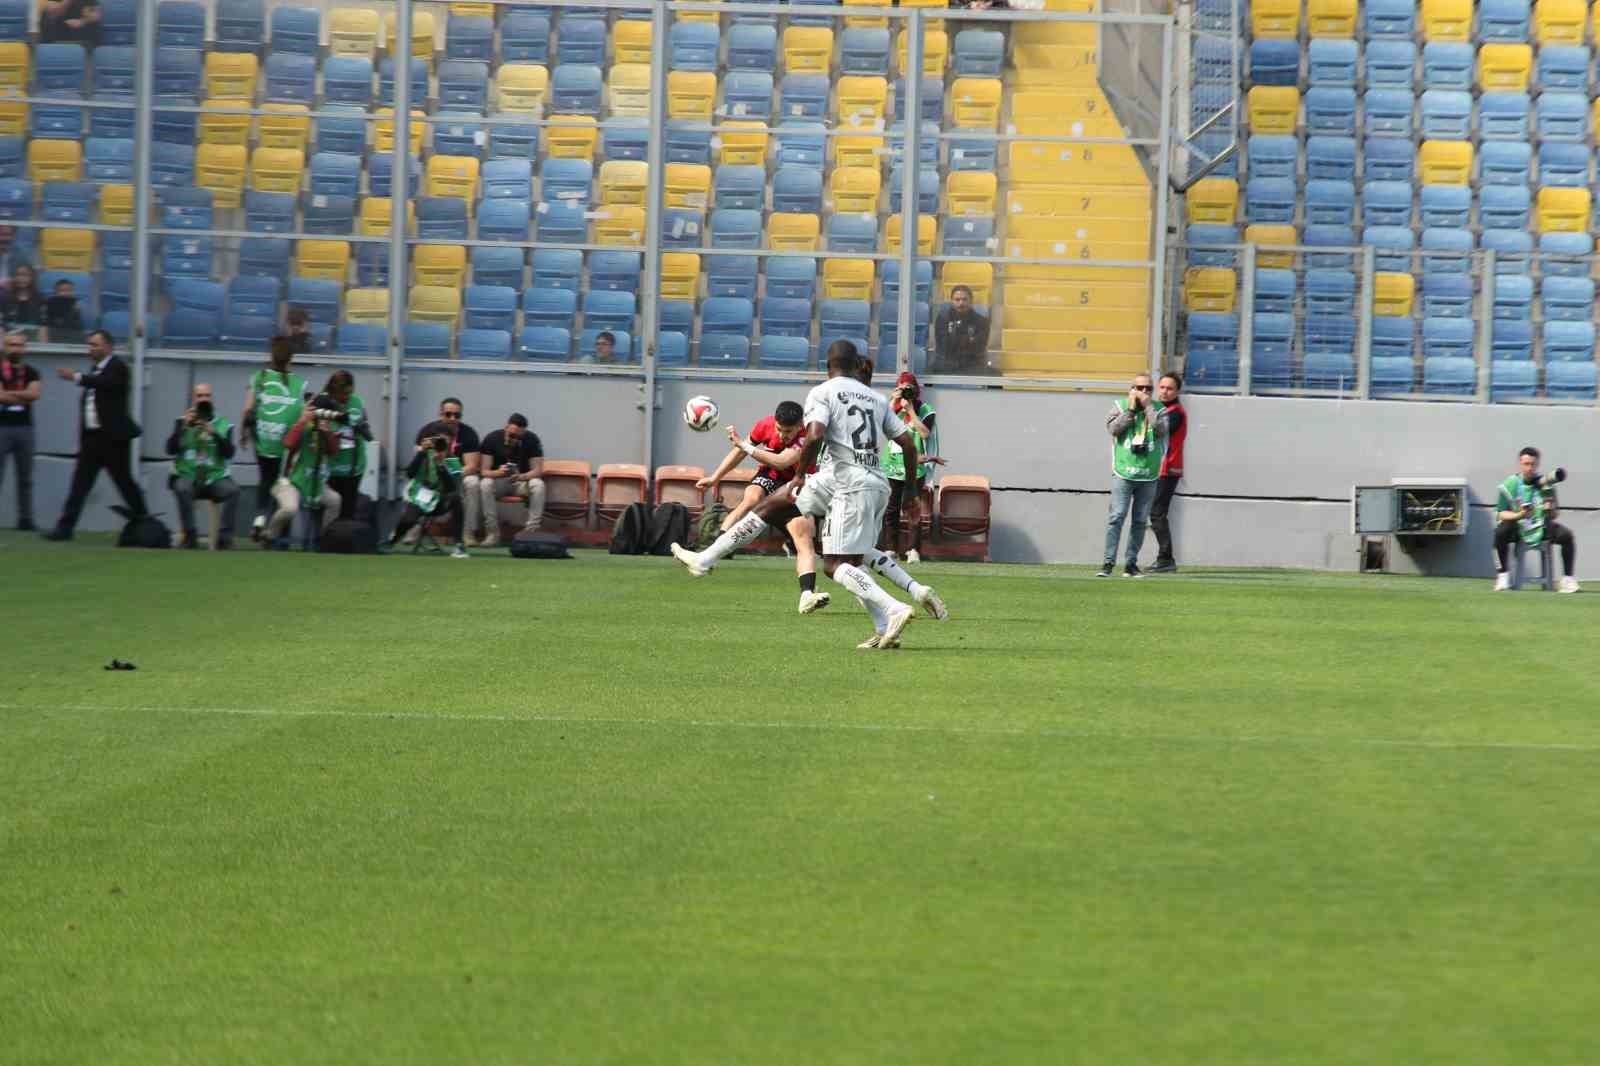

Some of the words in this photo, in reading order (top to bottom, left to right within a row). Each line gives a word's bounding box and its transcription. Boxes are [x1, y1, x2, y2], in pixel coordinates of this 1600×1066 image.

[1087, 100, 1096, 113] 9
[1081, 198, 1090, 211] 7
[1080, 291, 1089, 305] 5
[1077, 337, 1087, 350] 4
[848, 404, 877, 450] 21
